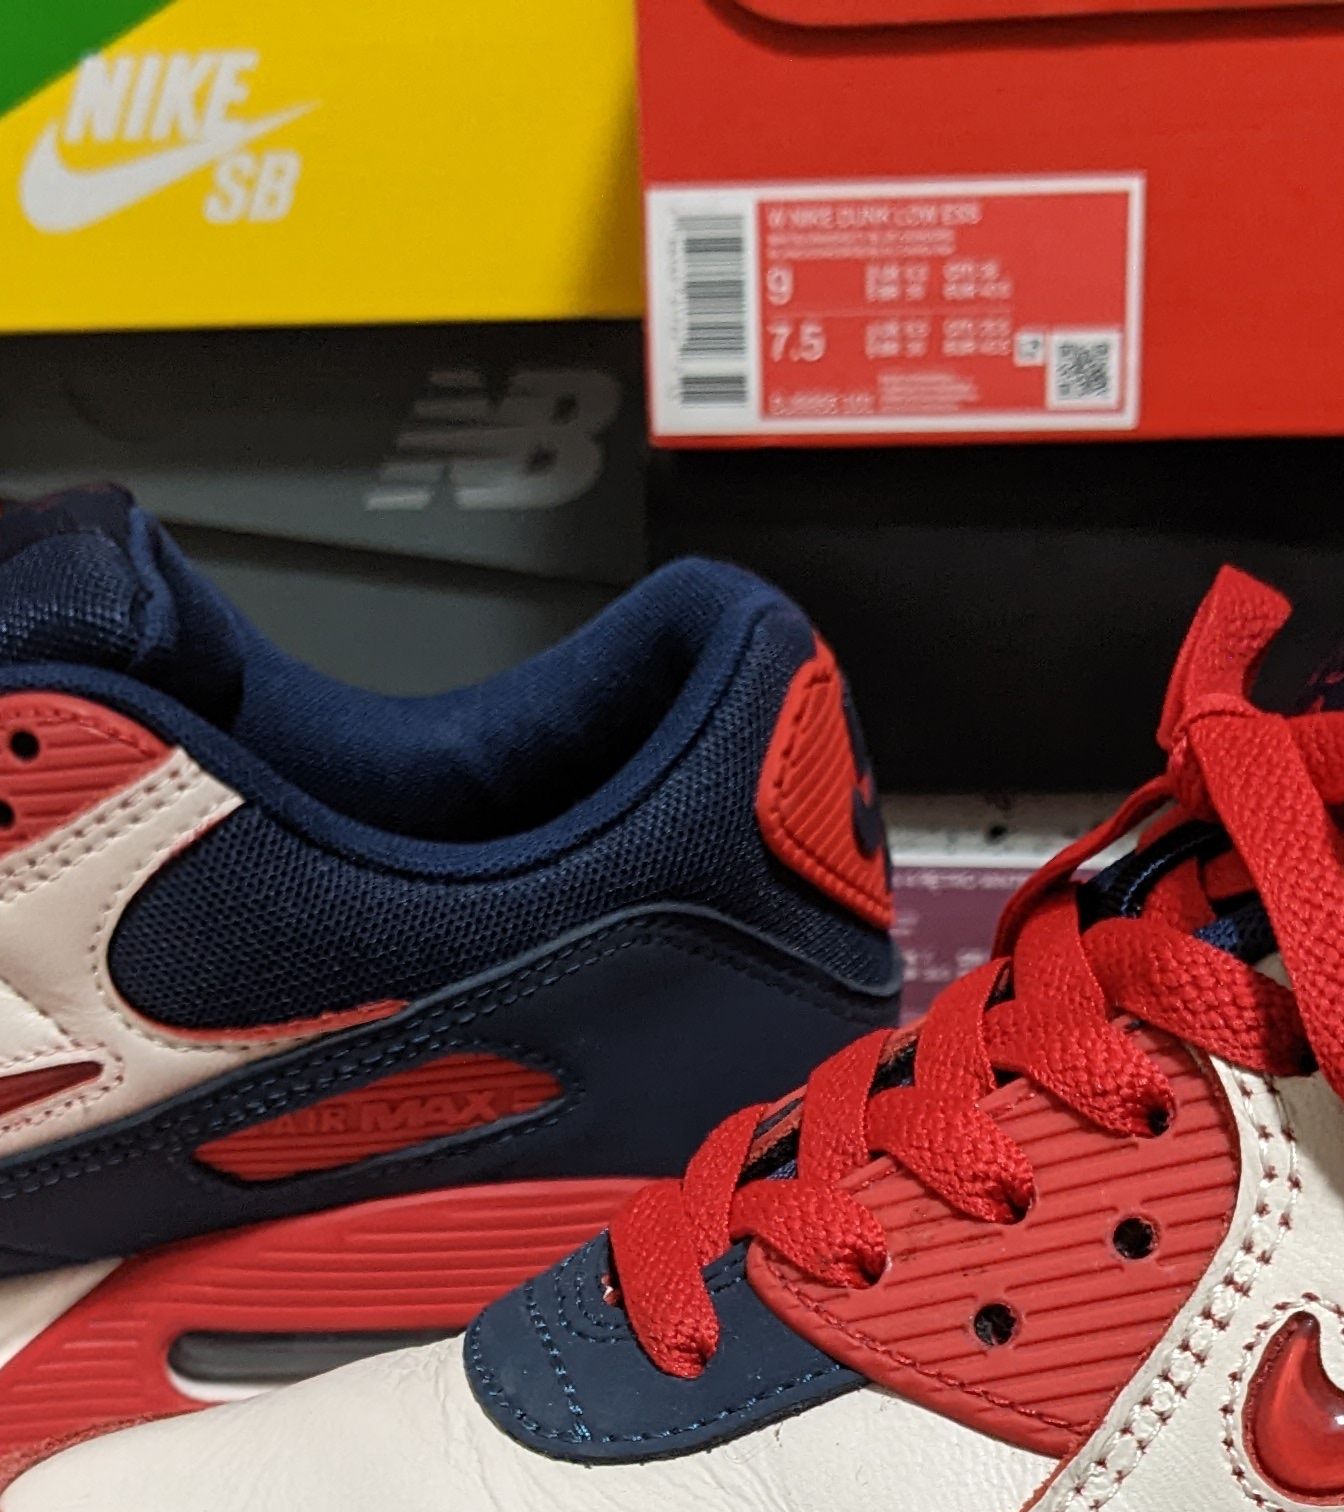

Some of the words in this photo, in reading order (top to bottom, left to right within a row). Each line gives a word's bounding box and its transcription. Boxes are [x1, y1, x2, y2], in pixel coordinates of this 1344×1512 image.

[61, 48, 260, 144] NIKE
[202, 148, 303, 226] SB
[766, 266, 794, 305] 9
[766, 320, 827, 362] 7.5
[277, 1105, 350, 1135] AIR
[359, 1089, 500, 1133] MAX
